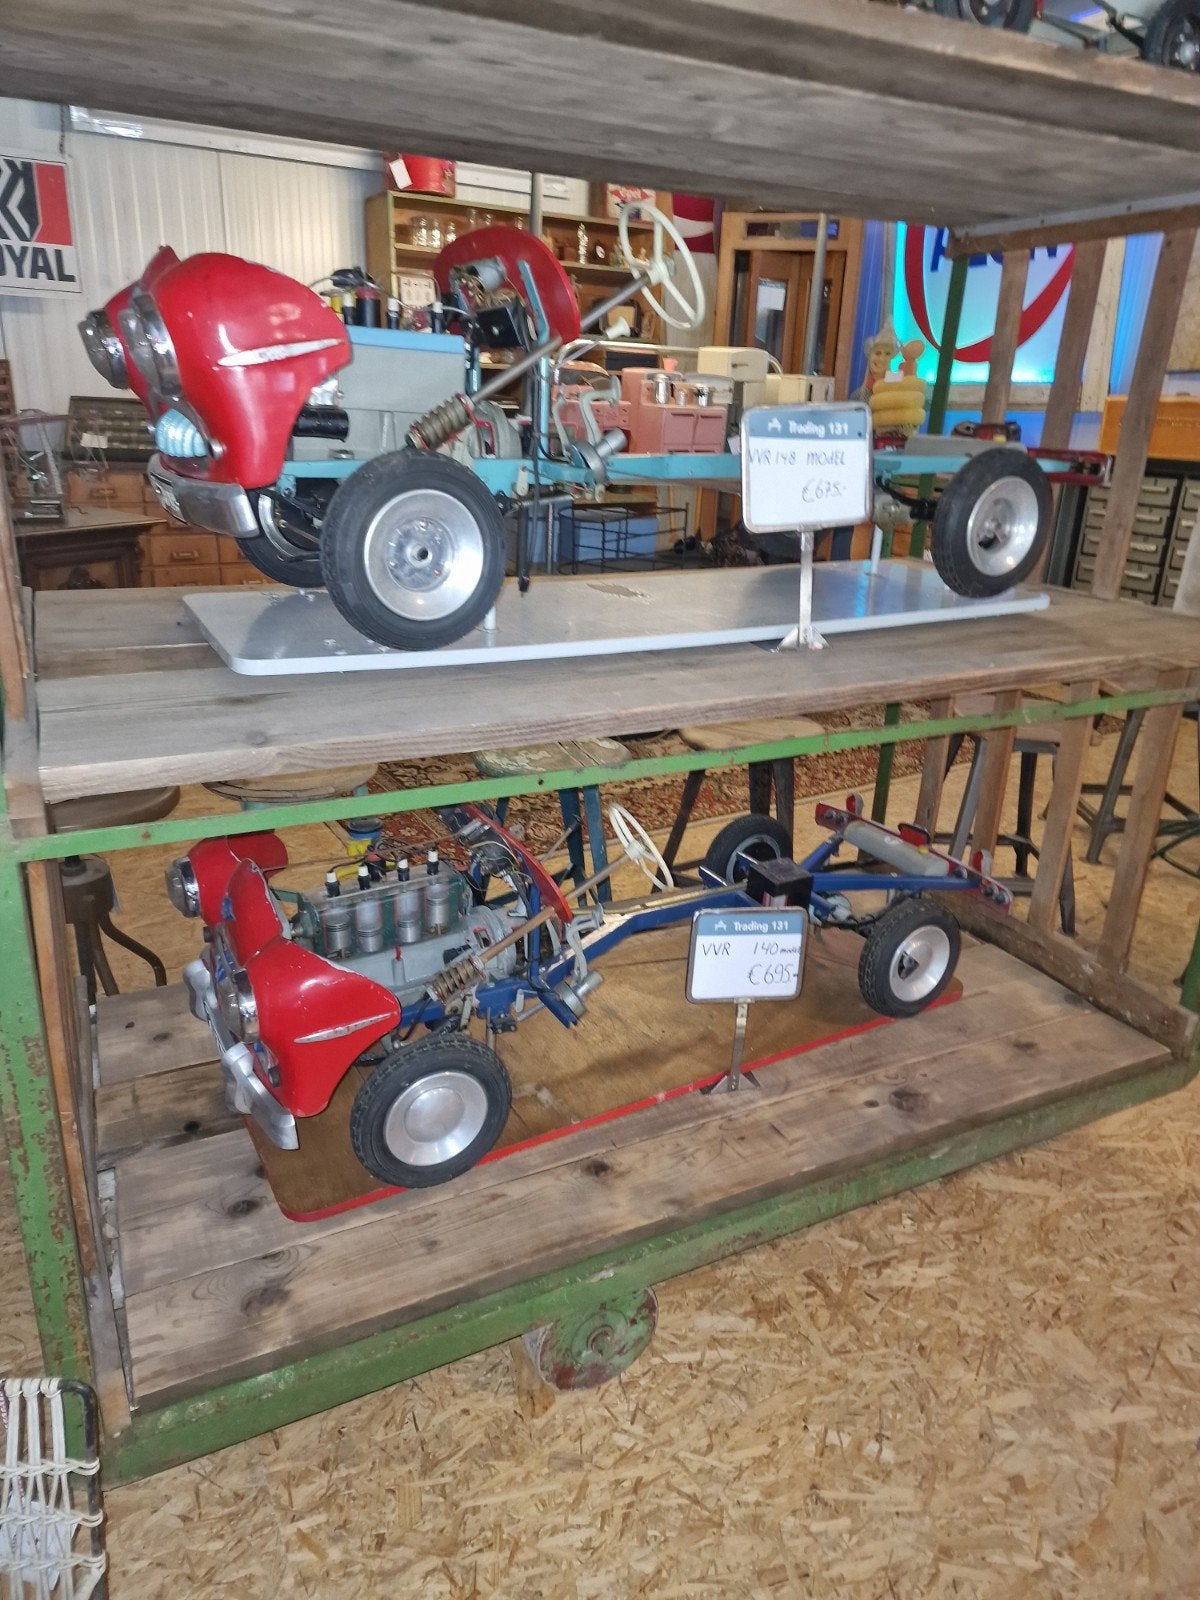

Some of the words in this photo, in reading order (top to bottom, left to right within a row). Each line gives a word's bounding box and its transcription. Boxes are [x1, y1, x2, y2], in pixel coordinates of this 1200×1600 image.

[0, 243, 76, 282] YAL
[788, 420, 826, 438] Trading
[828, 421, 849, 435] 131
[733, 921, 769, 934] Trading
[771, 920, 789, 931] 131
[702, 942, 731, 957] VVR
[753, 942, 779, 955] 140
